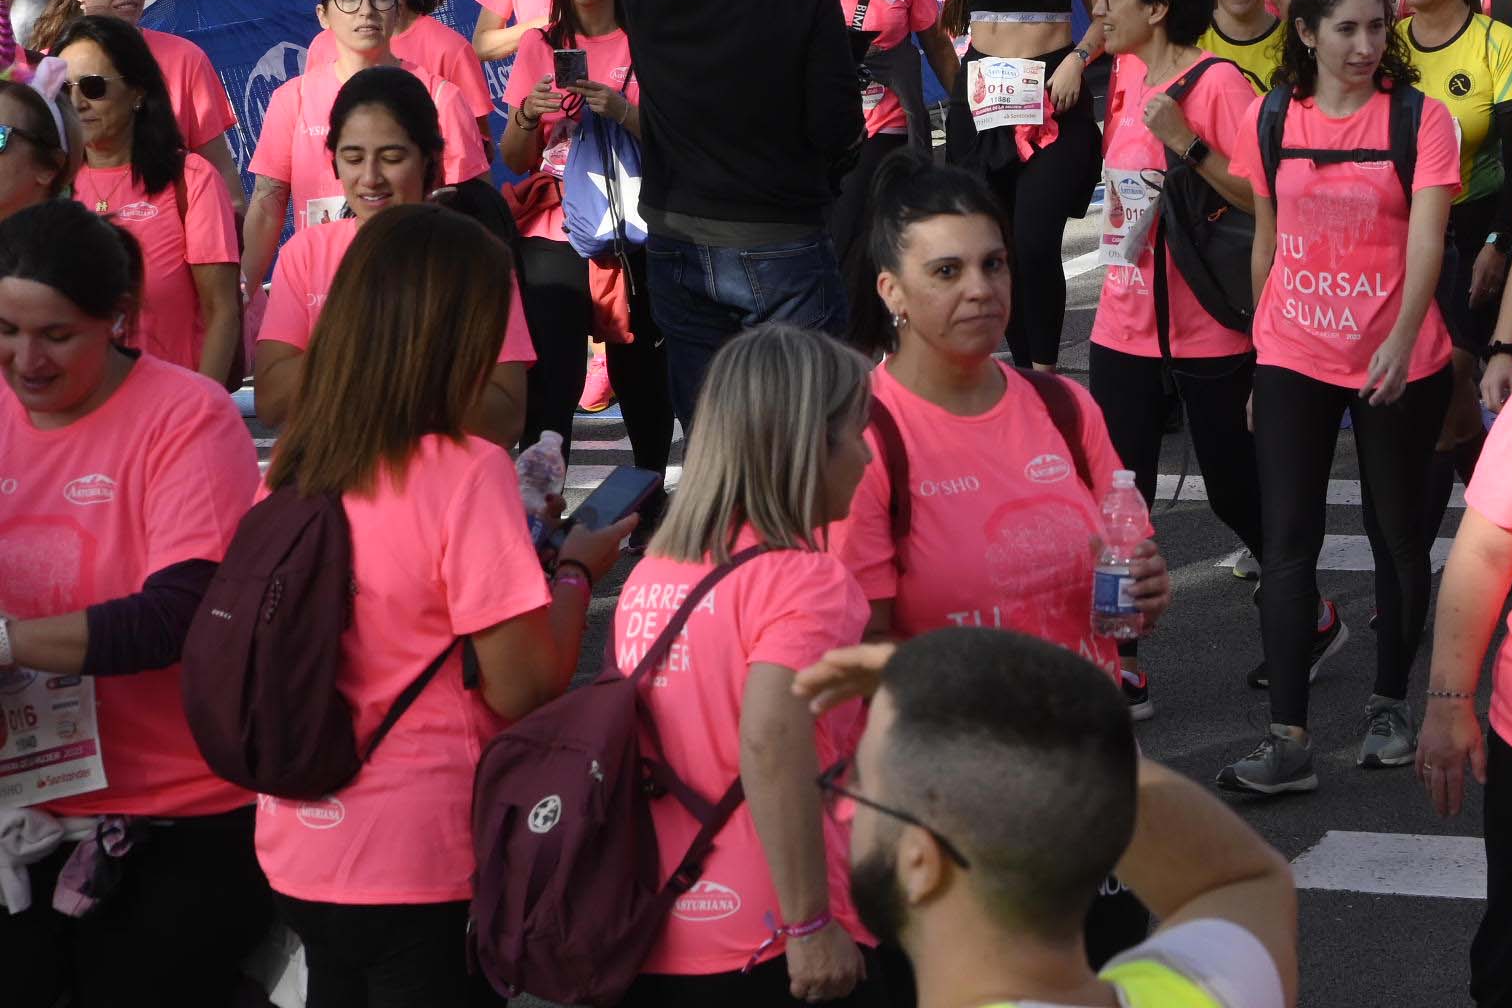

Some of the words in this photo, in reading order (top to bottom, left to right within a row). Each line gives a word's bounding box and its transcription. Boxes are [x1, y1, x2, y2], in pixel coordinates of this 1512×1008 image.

[987, 83, 1015, 95] 016
[1280, 232, 1304, 259] TU
[1284, 267, 1389, 297] DORSAL
[1282, 298, 1359, 331] SUMA
[622, 583, 715, 614] CARREA
[626, 612, 657, 639] DE
